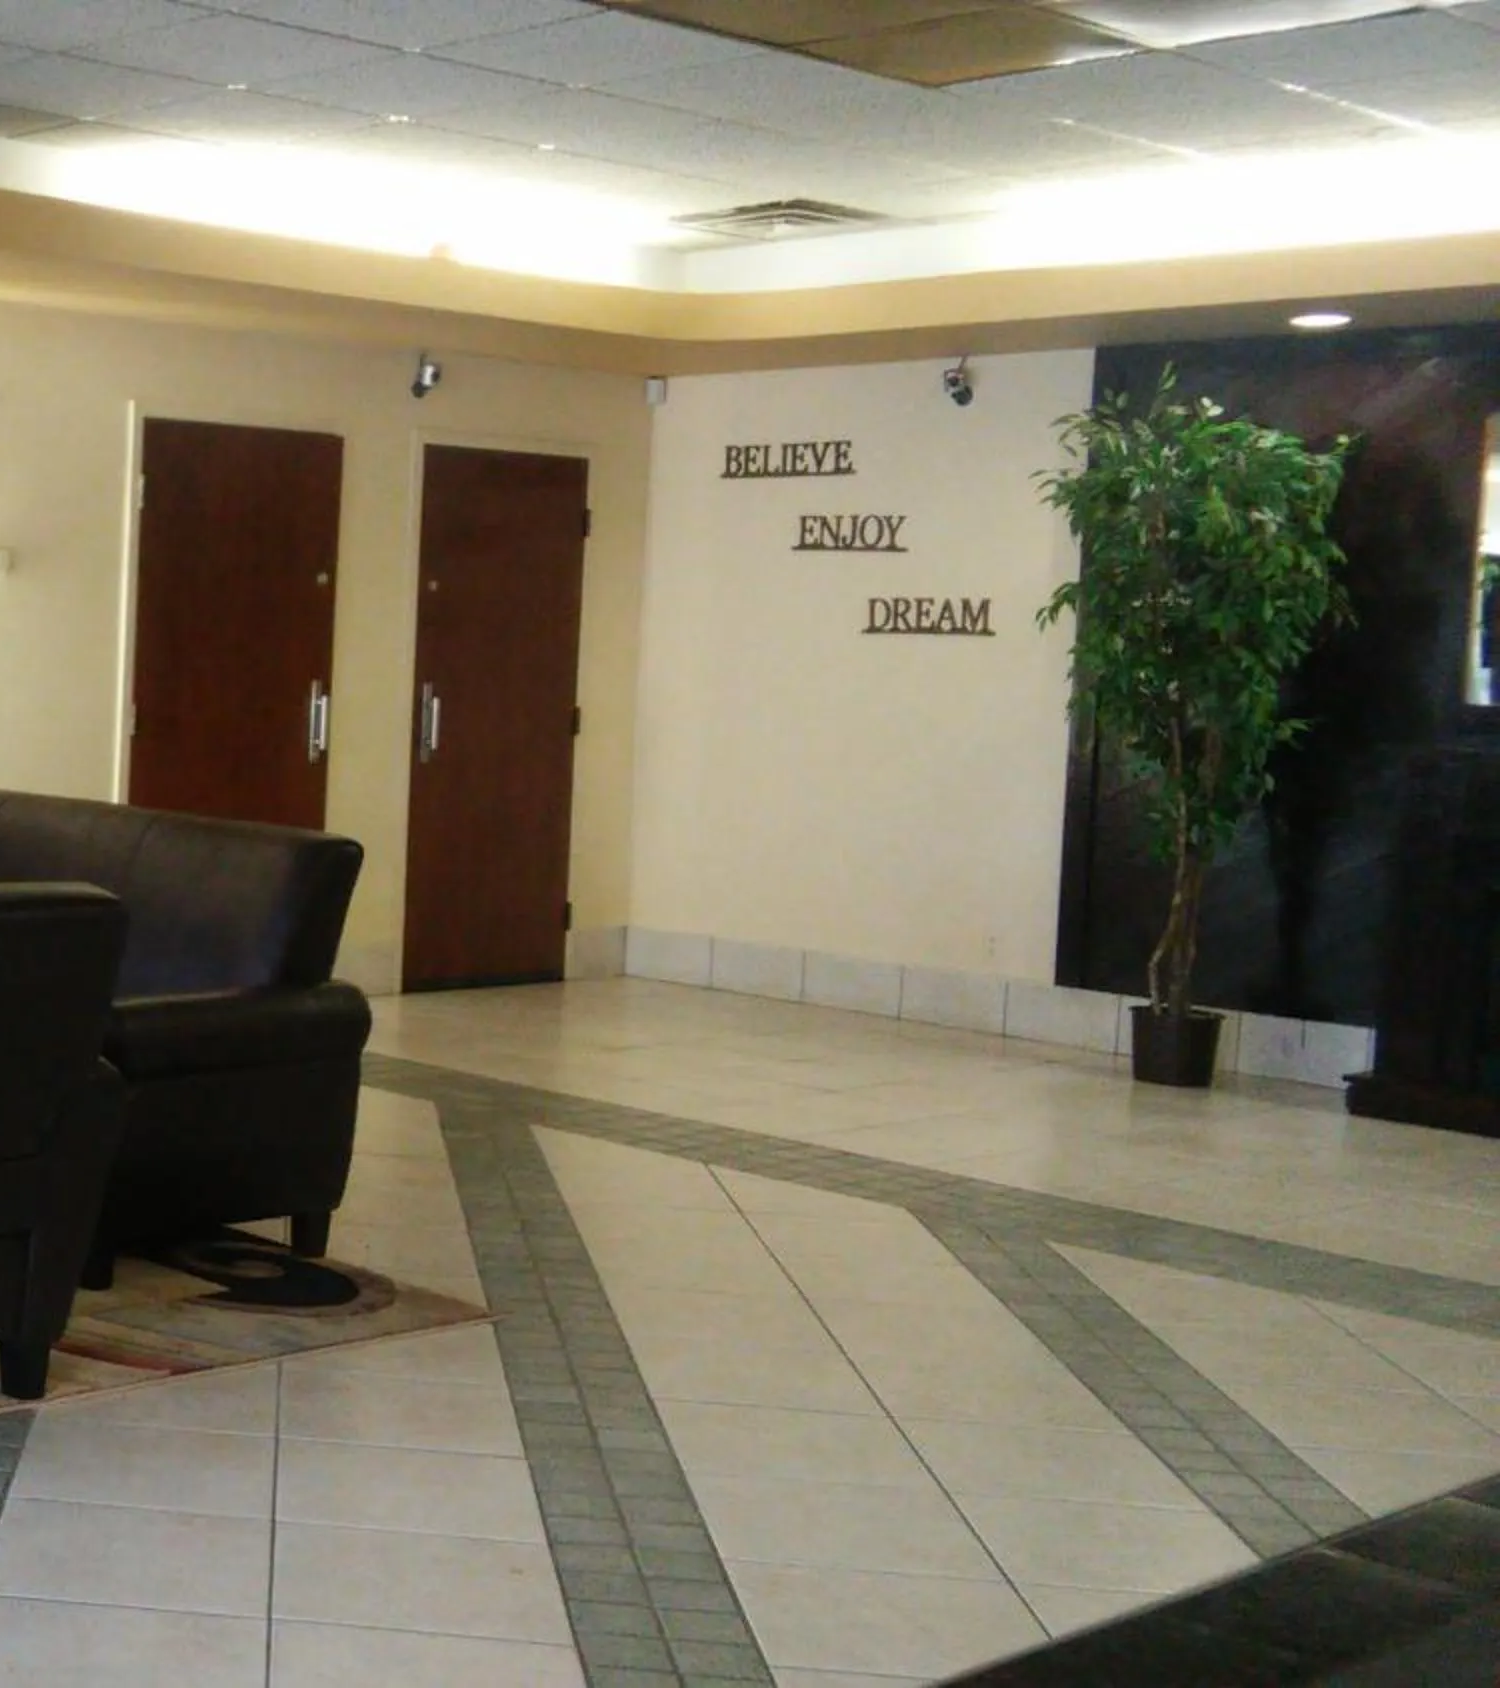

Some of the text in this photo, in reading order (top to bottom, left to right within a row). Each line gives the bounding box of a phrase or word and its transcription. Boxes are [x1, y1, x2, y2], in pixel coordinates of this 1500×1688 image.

[722, 440, 855, 477] BELIEVE
[794, 514, 908, 551] ENJOY
[863, 597, 995, 635] DREAM
